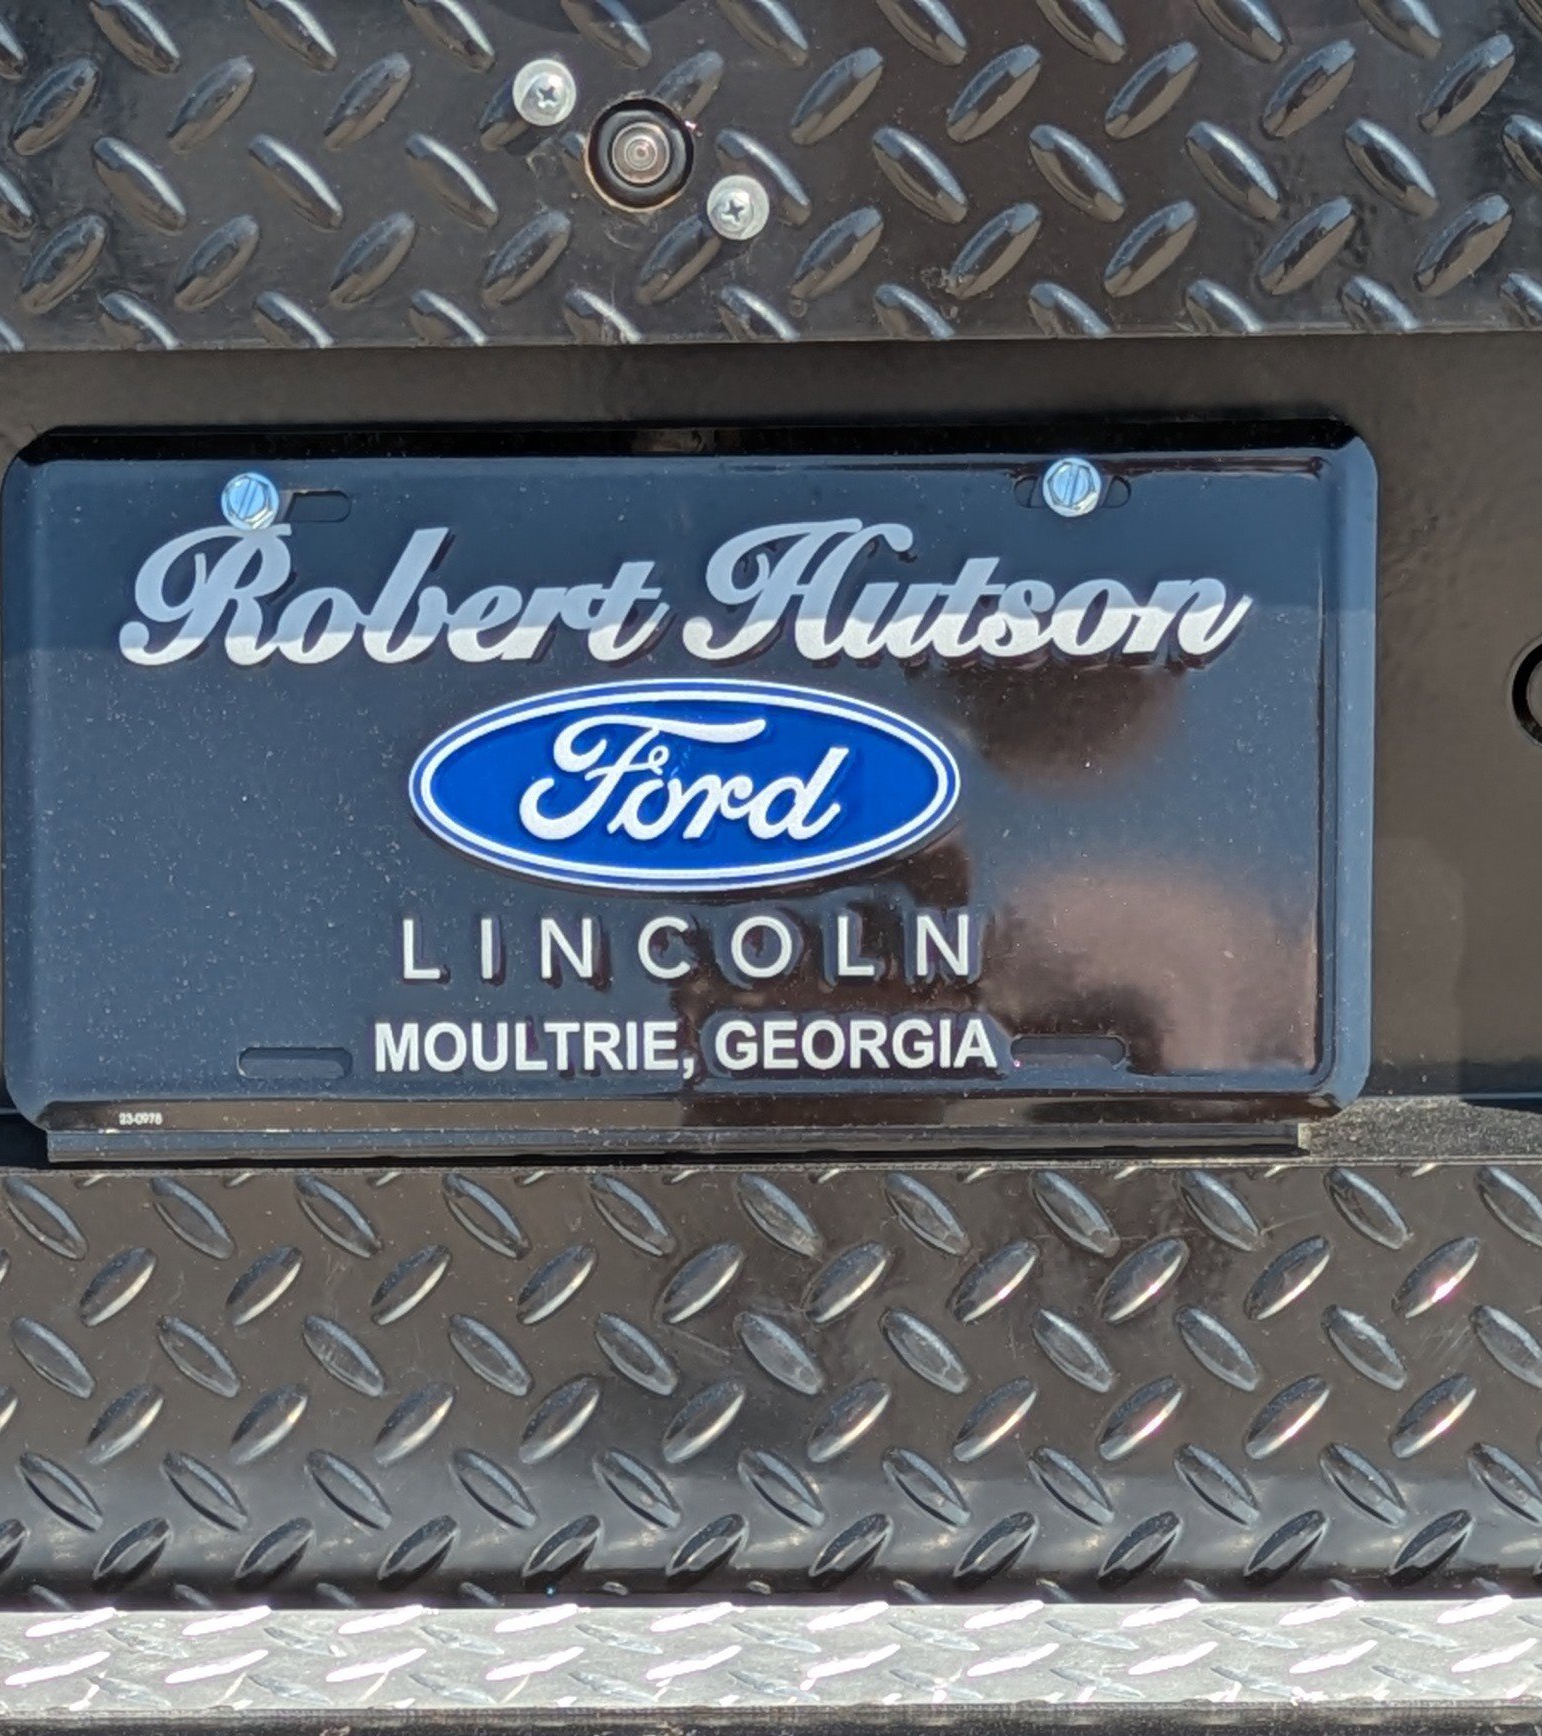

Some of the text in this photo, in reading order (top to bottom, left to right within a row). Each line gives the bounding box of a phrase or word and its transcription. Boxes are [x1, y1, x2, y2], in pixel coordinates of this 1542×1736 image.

[119, 517, 1253, 666] Robert Hutson
[519, 714, 850, 841] Ford
[401, 914, 970, 980] LINCOLN
[374, 1018, 998, 1078] MOULTRIE, GEORGIA
